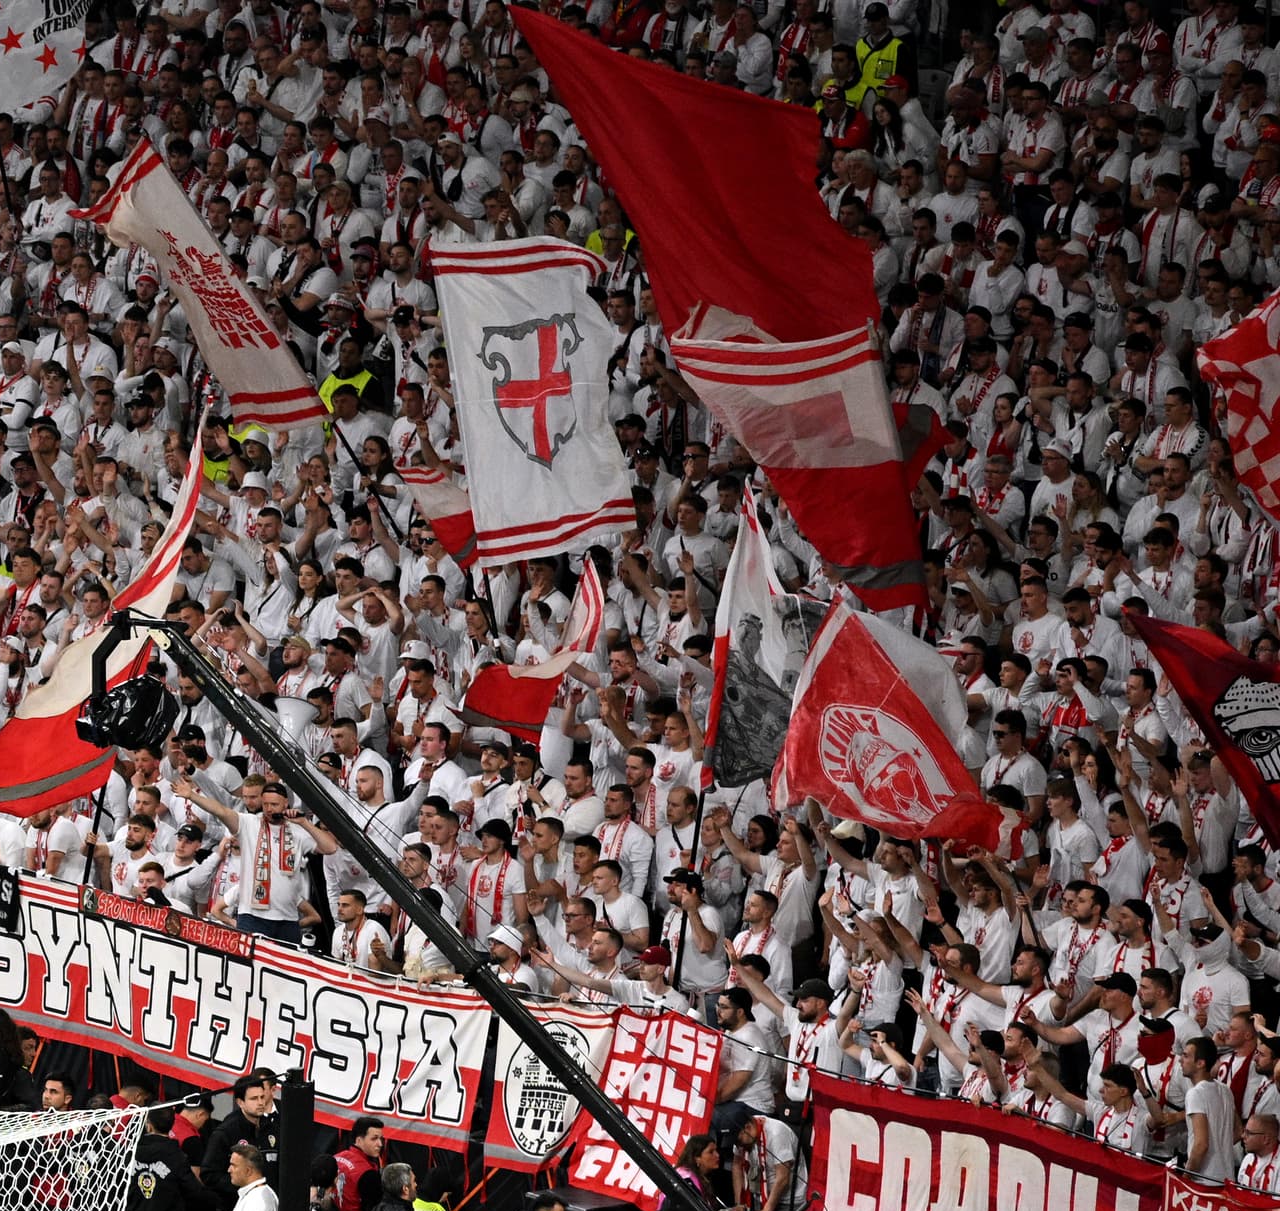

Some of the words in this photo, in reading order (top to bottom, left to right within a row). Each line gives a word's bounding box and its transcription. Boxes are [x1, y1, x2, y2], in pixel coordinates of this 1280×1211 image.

[98, 892, 135, 927] SPORT
[137, 907, 169, 932] CLUB
[180, 917, 242, 955] FREIBURG
[613, 1014, 718, 1073] FUSS
[604, 1059, 707, 1118] BALL
